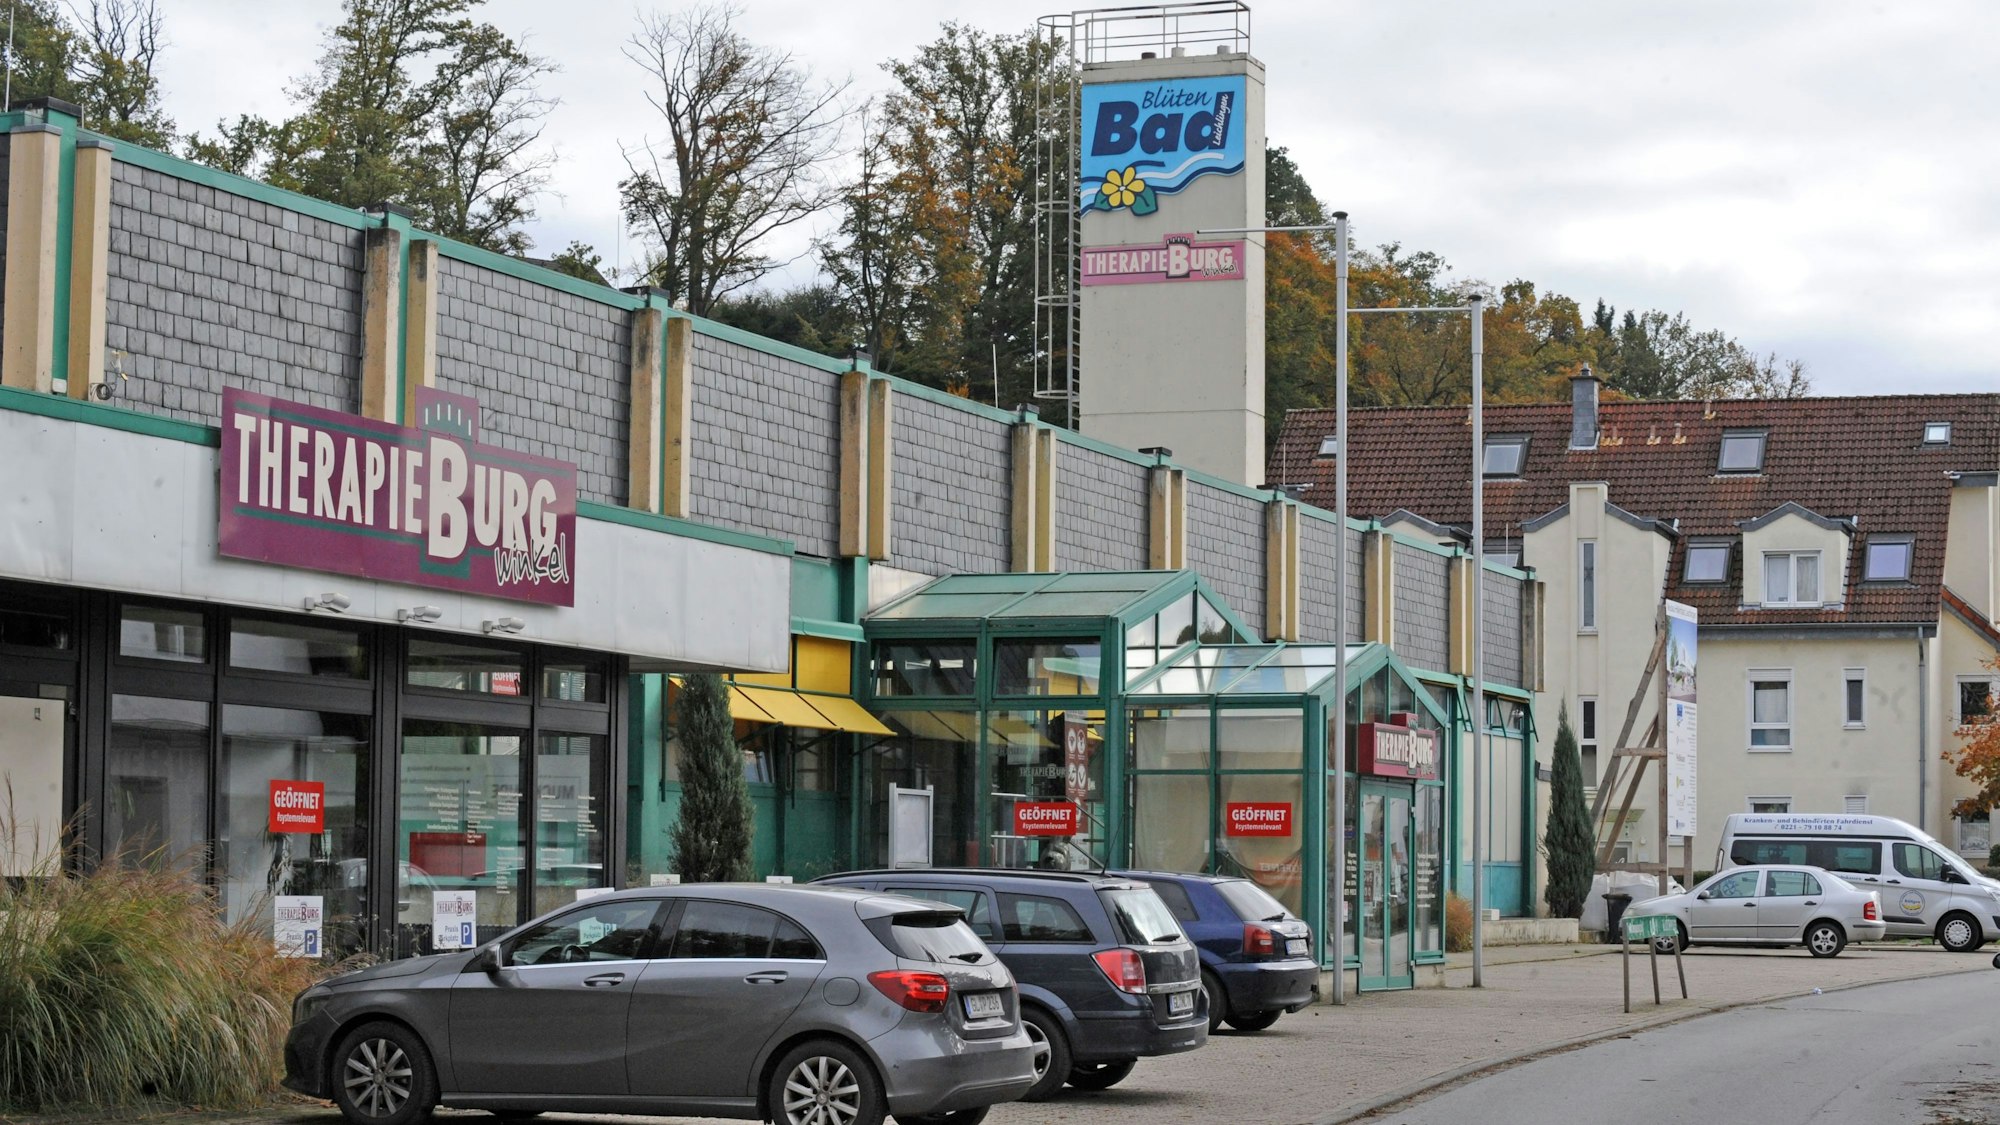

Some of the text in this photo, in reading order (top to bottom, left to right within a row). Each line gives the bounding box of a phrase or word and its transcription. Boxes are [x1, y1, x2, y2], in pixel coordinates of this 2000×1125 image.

[1142, 86, 1213, 109] Blüten
[1091, 91, 1235, 156] Bad
[1212, 93, 1231, 146] Leichlingen
[494, 532, 569, 586] winkel
[273, 786, 320, 809] GEÖFFNET
[1019, 806, 1072, 820] GEÖFFNET
[1231, 806, 1286, 821] GEÖFFNET
[1022, 822, 1068, 831] #systemrelevant
[1235, 823, 1282, 831] #systemrelevant
